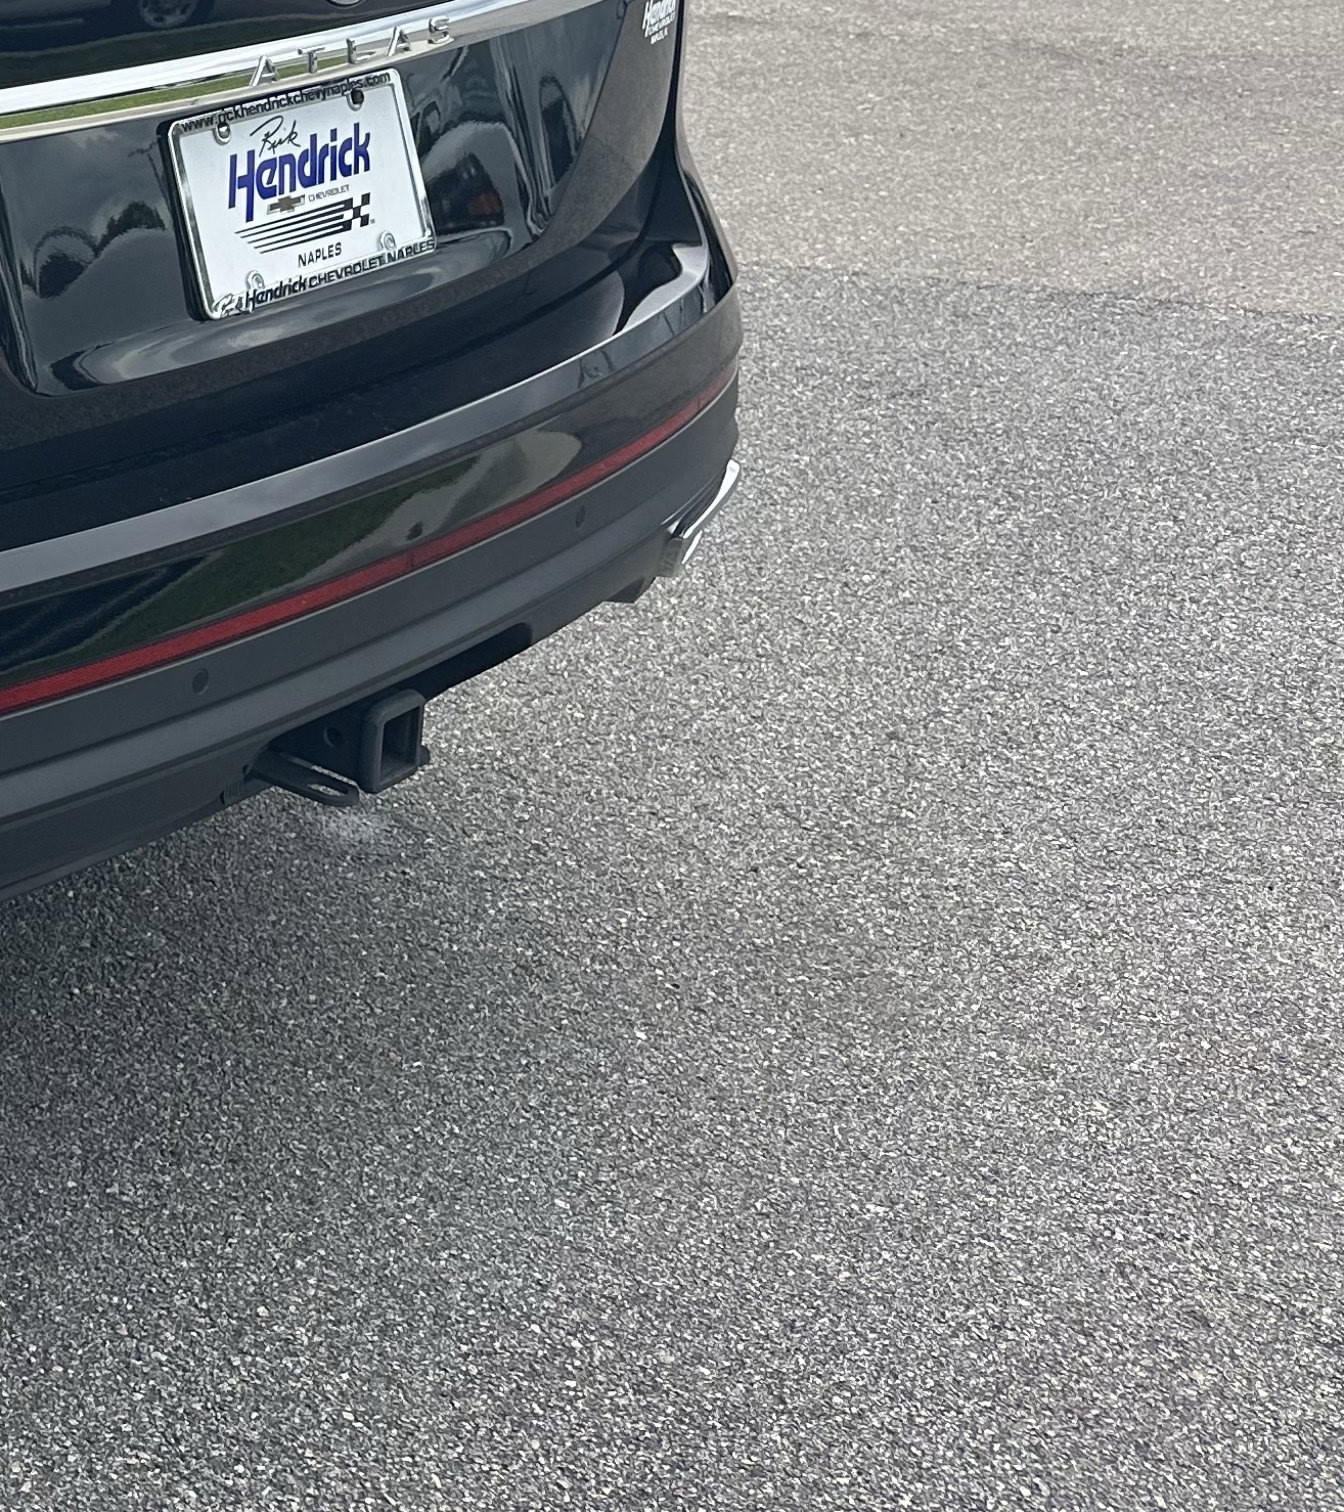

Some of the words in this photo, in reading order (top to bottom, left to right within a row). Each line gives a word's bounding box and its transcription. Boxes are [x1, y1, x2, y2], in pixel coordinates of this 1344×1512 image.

[249, 16, 451, 87] ATLAS
[228, 122, 370, 223] Hendrick
[308, 184, 350, 202] CHEVROLET
[244, 275, 309, 310] Hendrick
[308, 254, 385, 288] CHEVROLET
[386, 238, 435, 264] NAPLES
[298, 242, 342, 268] NAPLES
